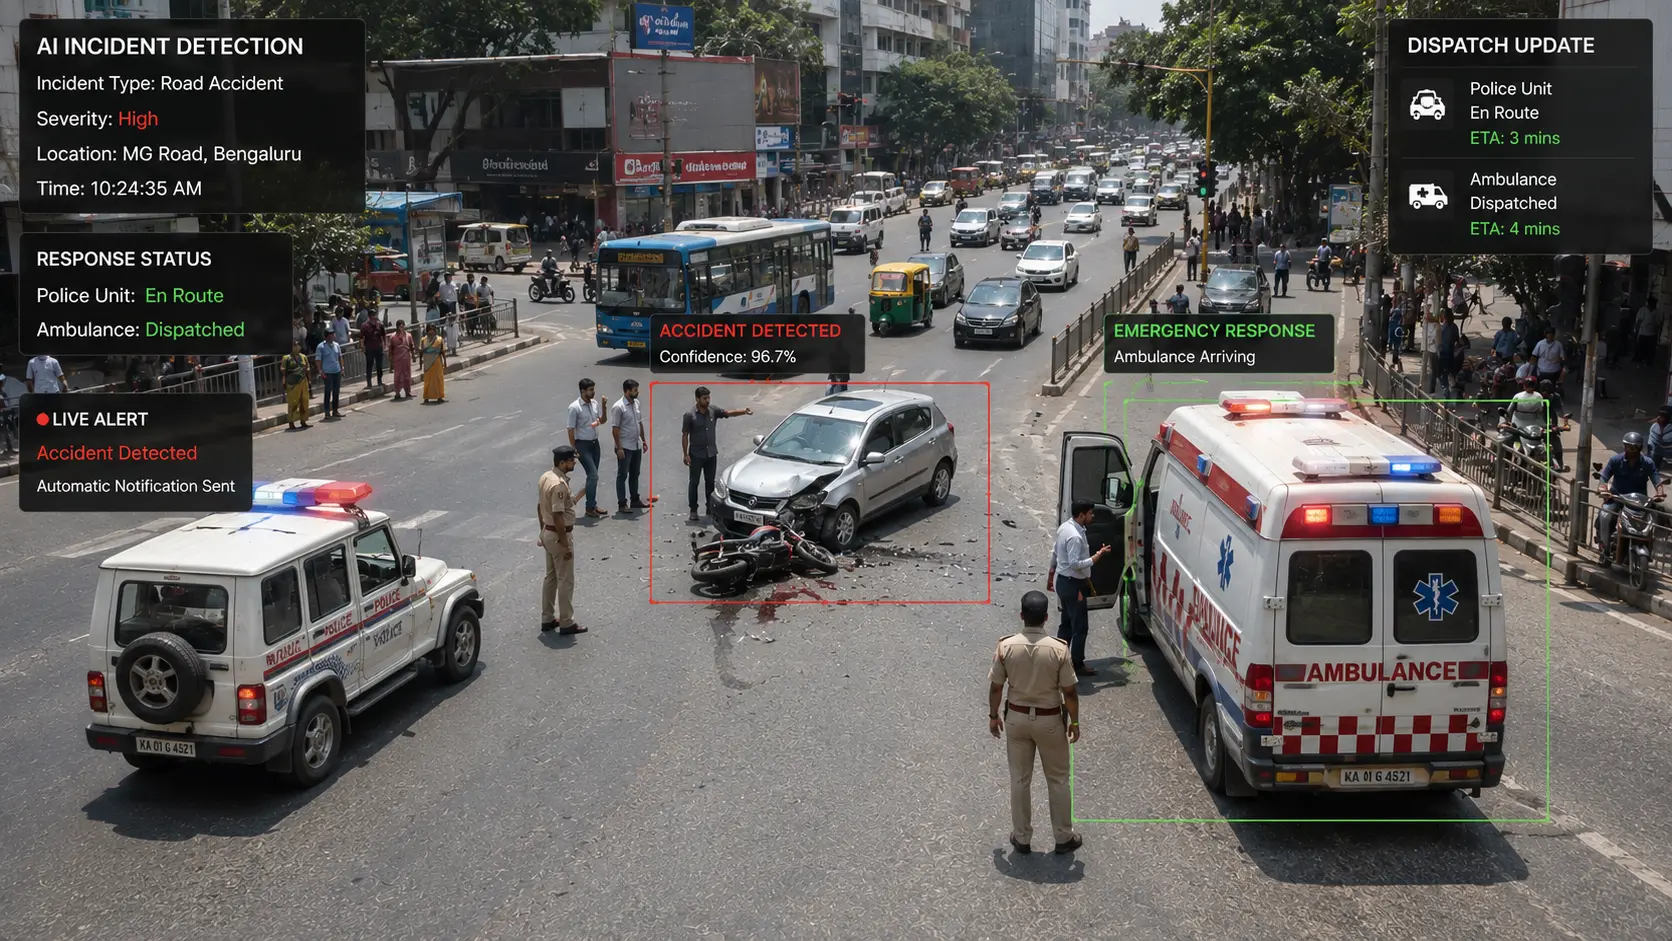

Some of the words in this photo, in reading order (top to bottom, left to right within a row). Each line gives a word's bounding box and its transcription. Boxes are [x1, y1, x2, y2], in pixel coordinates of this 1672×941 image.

[1306, 661, 1457, 682] AMBULANCE
[140, 739, 152, 751] KA
[153, 740, 163, 752] 01
[172, 742, 194, 755] 4521
[1344, 770, 1360, 783] KA
